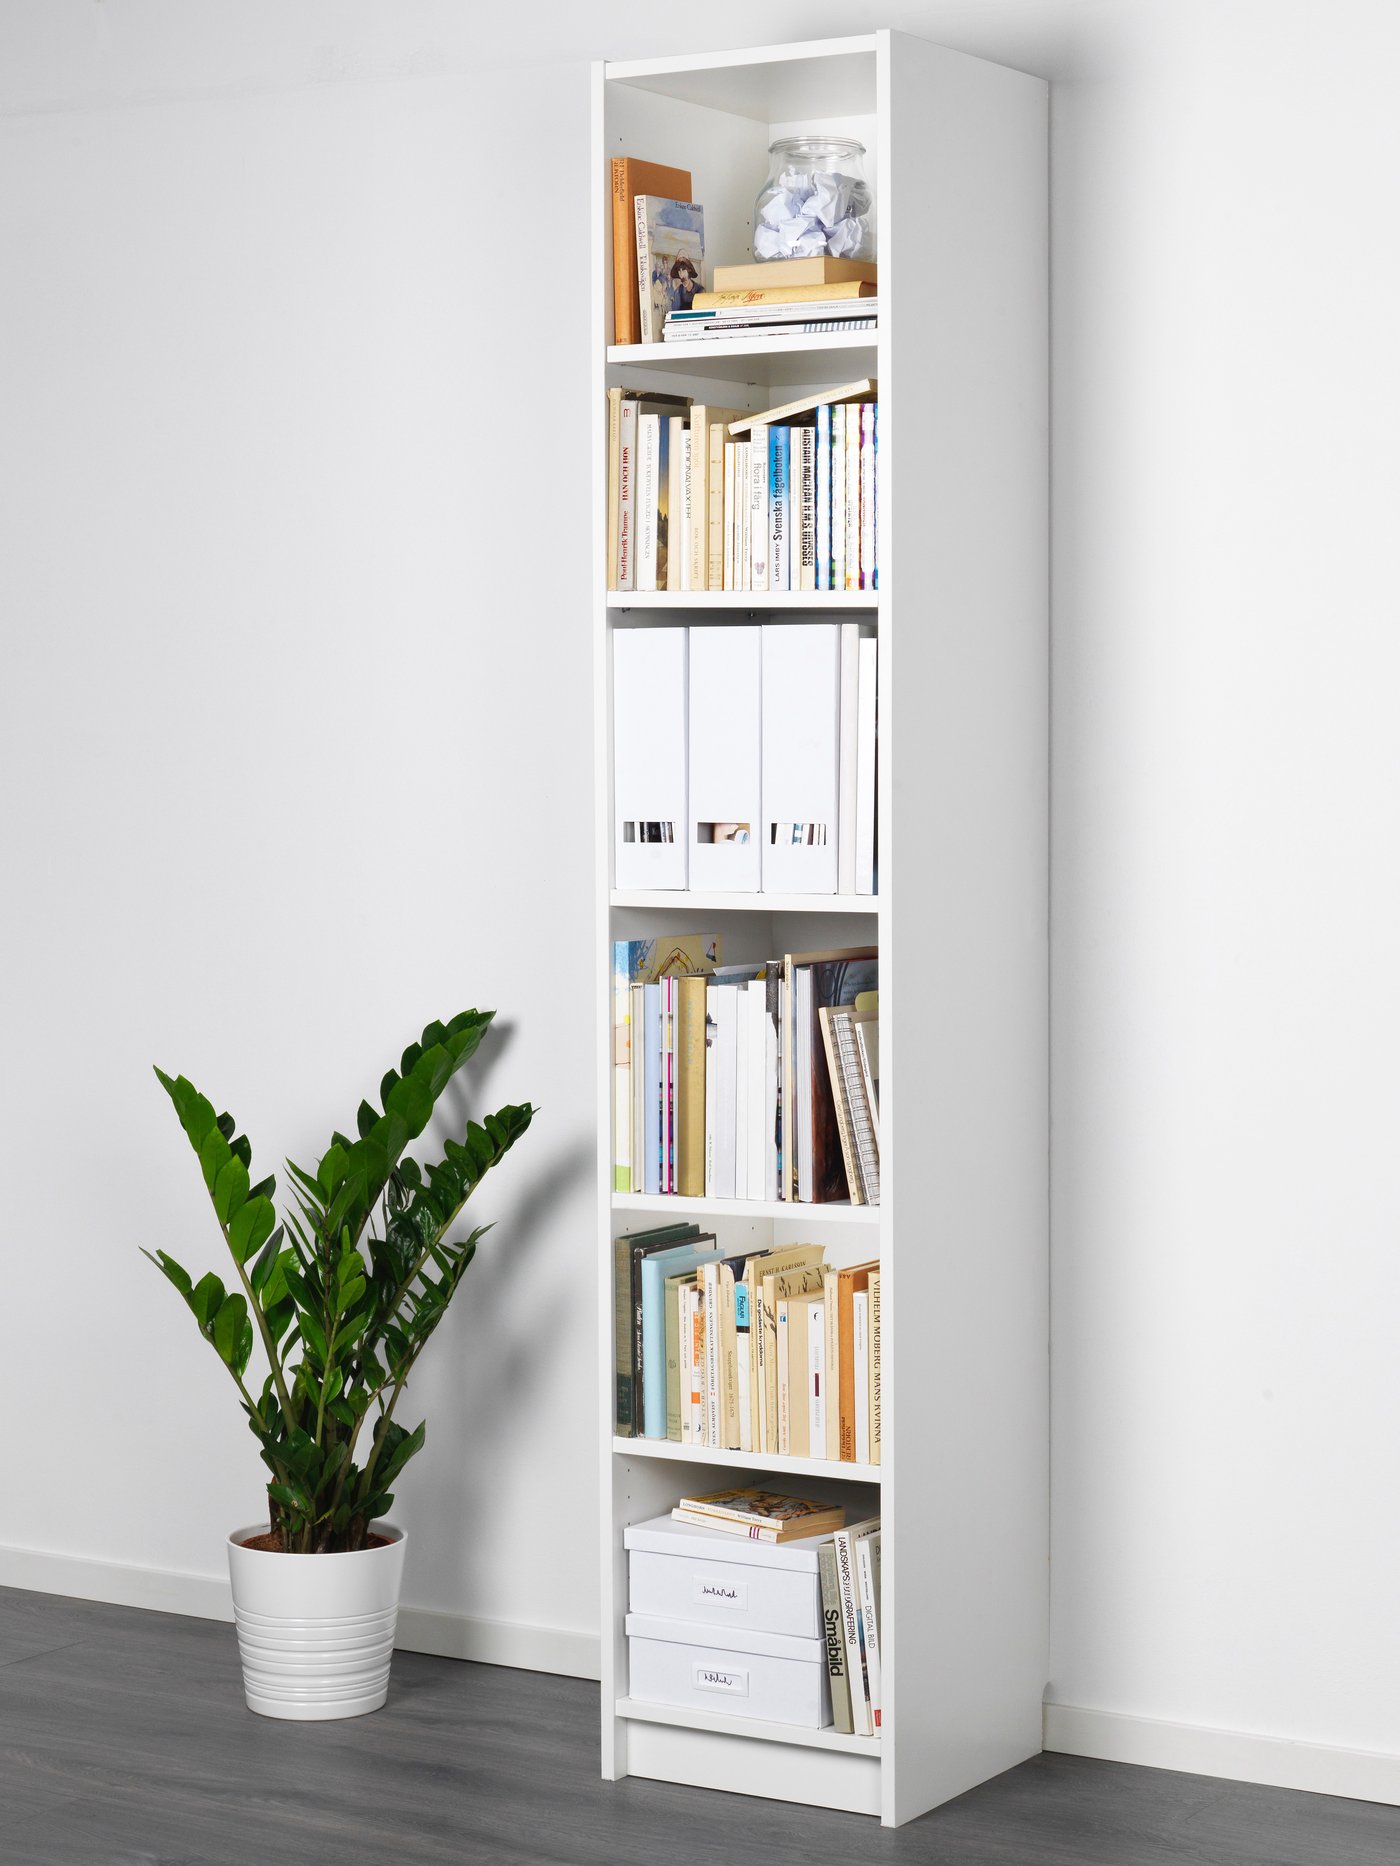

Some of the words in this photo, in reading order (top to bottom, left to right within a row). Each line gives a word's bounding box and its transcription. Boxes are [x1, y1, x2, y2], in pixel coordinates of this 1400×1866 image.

[753, 463, 762, 484] flora
[773, 445, 784, 498] fågelboken
[802, 466, 813, 502] MACLEAN
[773, 501, 783, 541] Svenska
[759, 1268, 774, 1278] ERNST
[781, 1261, 806, 1272] KARLSSON
[873, 1280, 881, 1323] VILHELM
[873, 1326, 881, 1369] MOBERG
[865, 1605, 873, 1632] DIGITAL
[825, 1609, 843, 1677] Småbild
[868, 1633, 876, 1649] BILD
